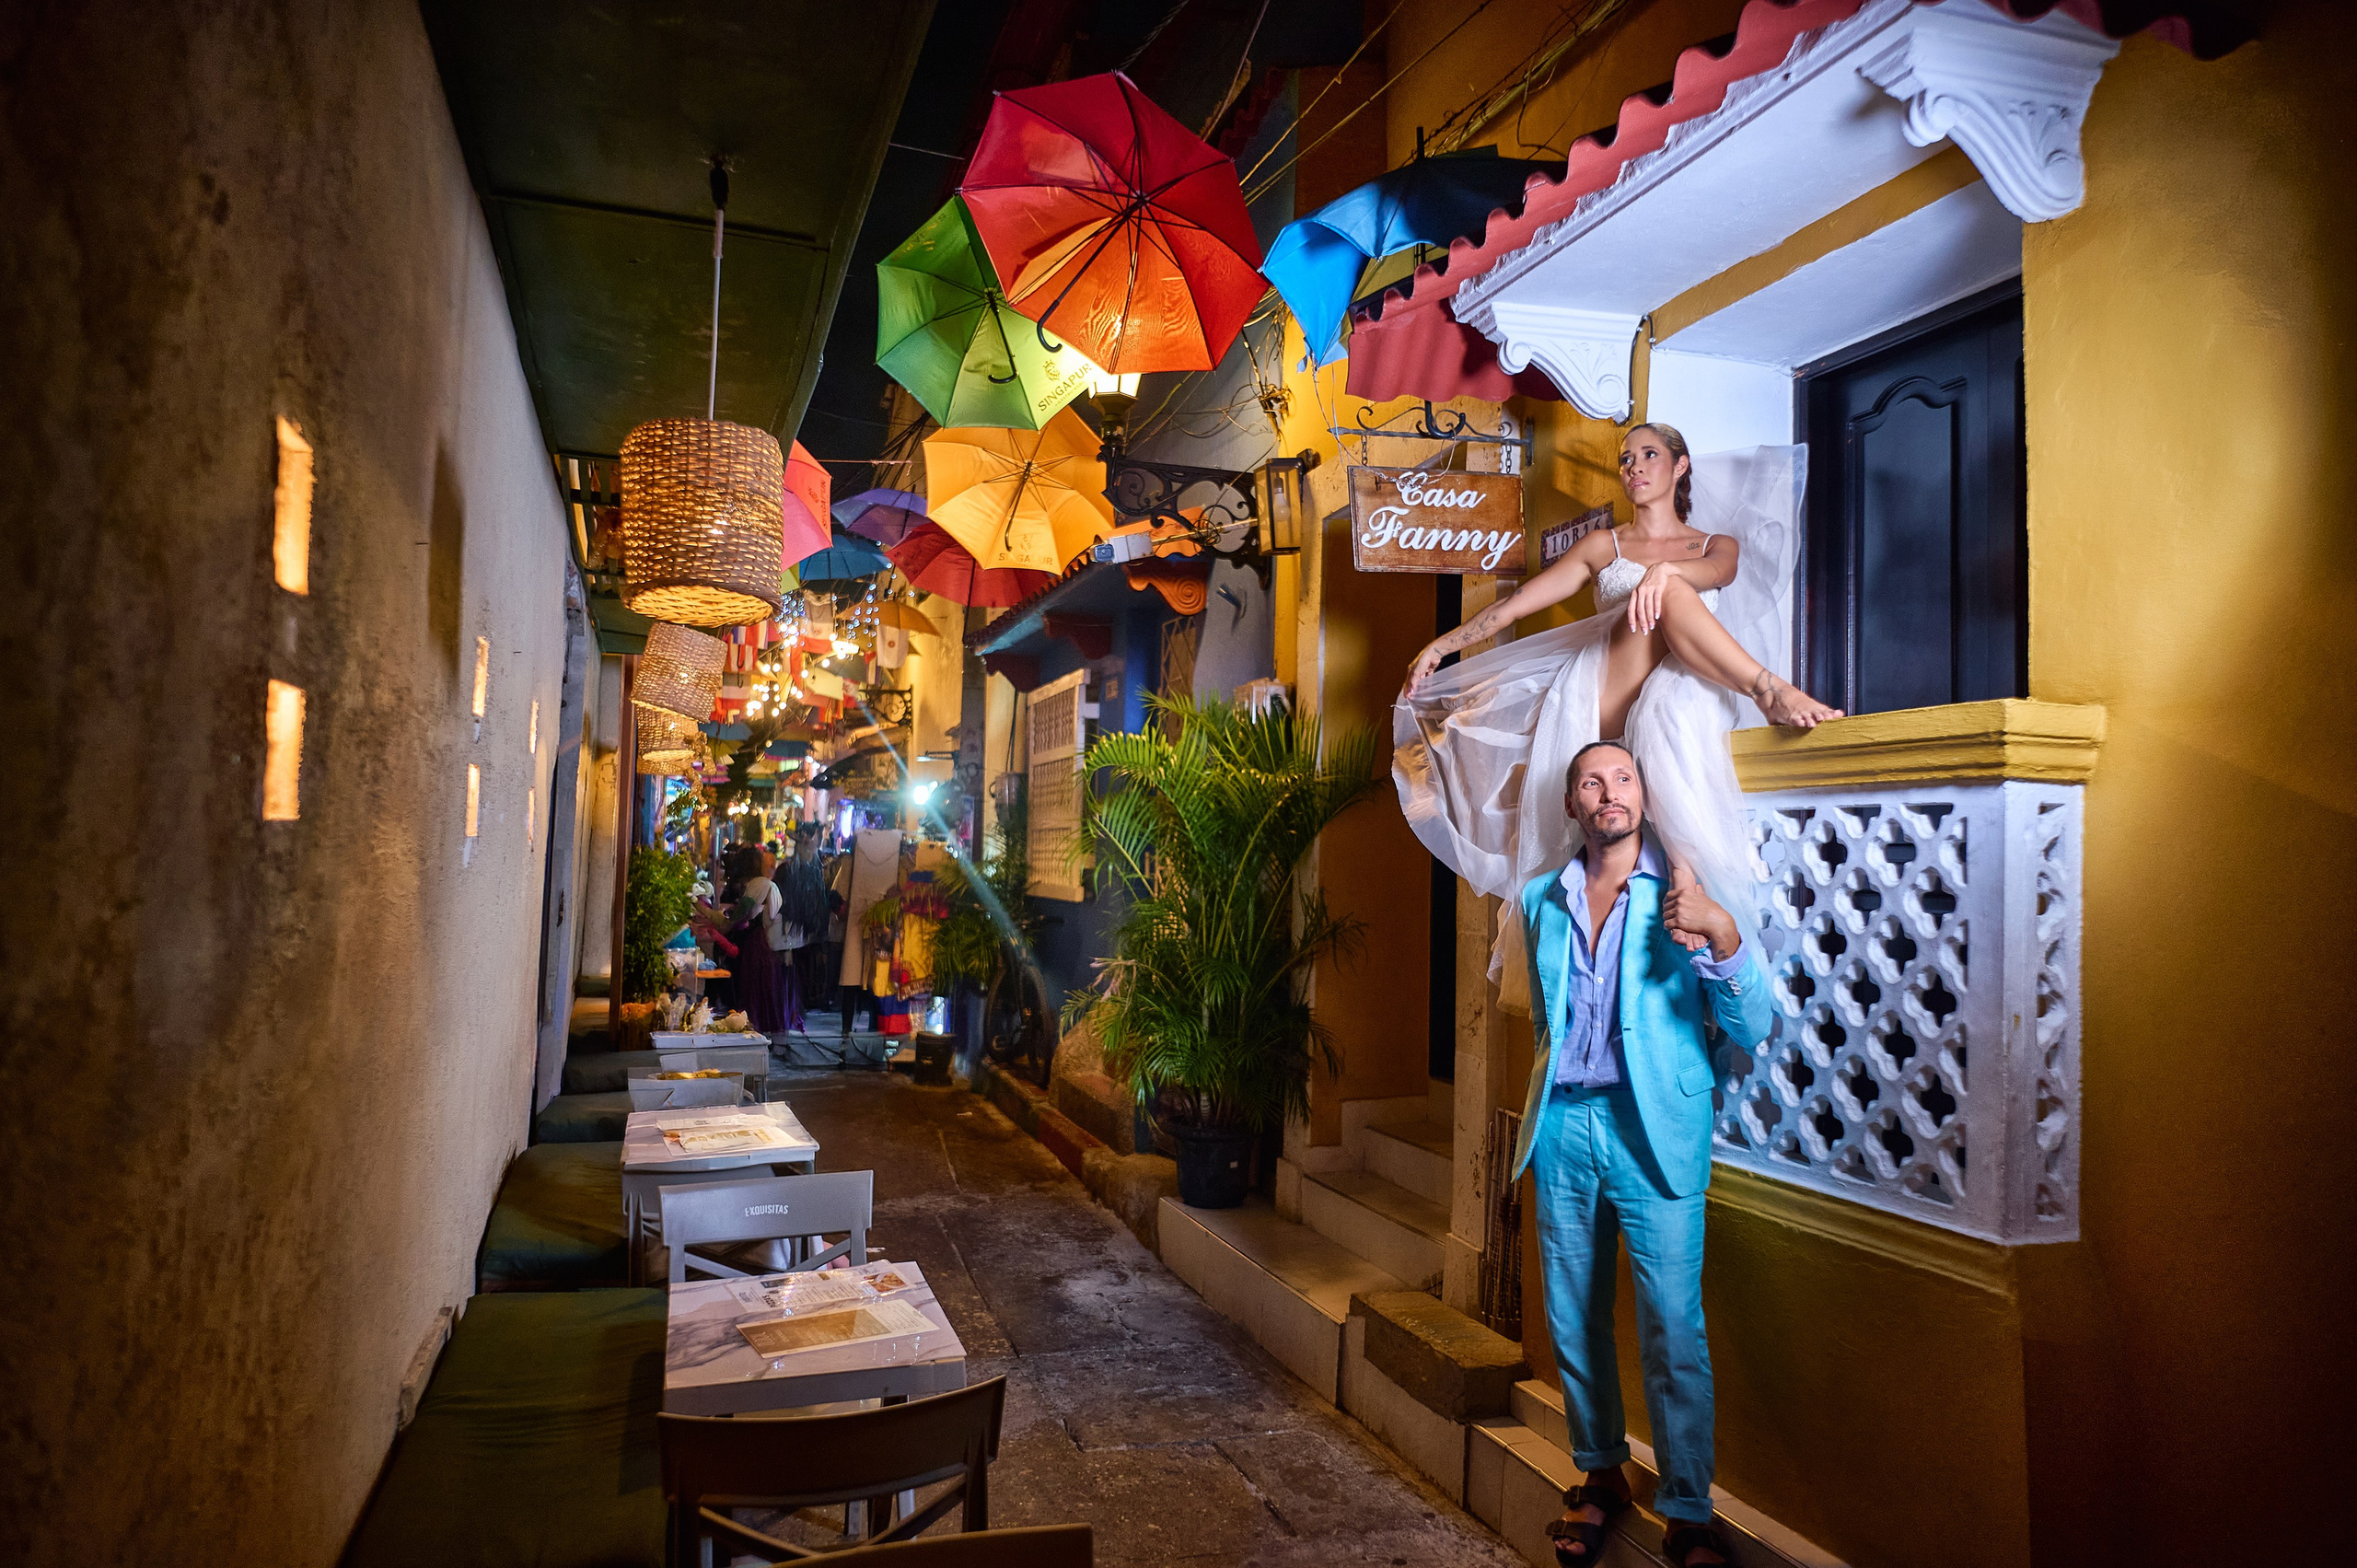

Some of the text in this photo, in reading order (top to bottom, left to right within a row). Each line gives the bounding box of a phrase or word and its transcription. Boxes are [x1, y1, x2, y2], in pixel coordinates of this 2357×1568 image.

[1038, 363, 1092, 412] SINGAPUR
[1396, 471, 1487, 508] Casa
[1361, 506, 1522, 571] Fanny
[999, 552, 1052, 564] SGAUR
[745, 1204, 789, 1216] EXQUISITAS
